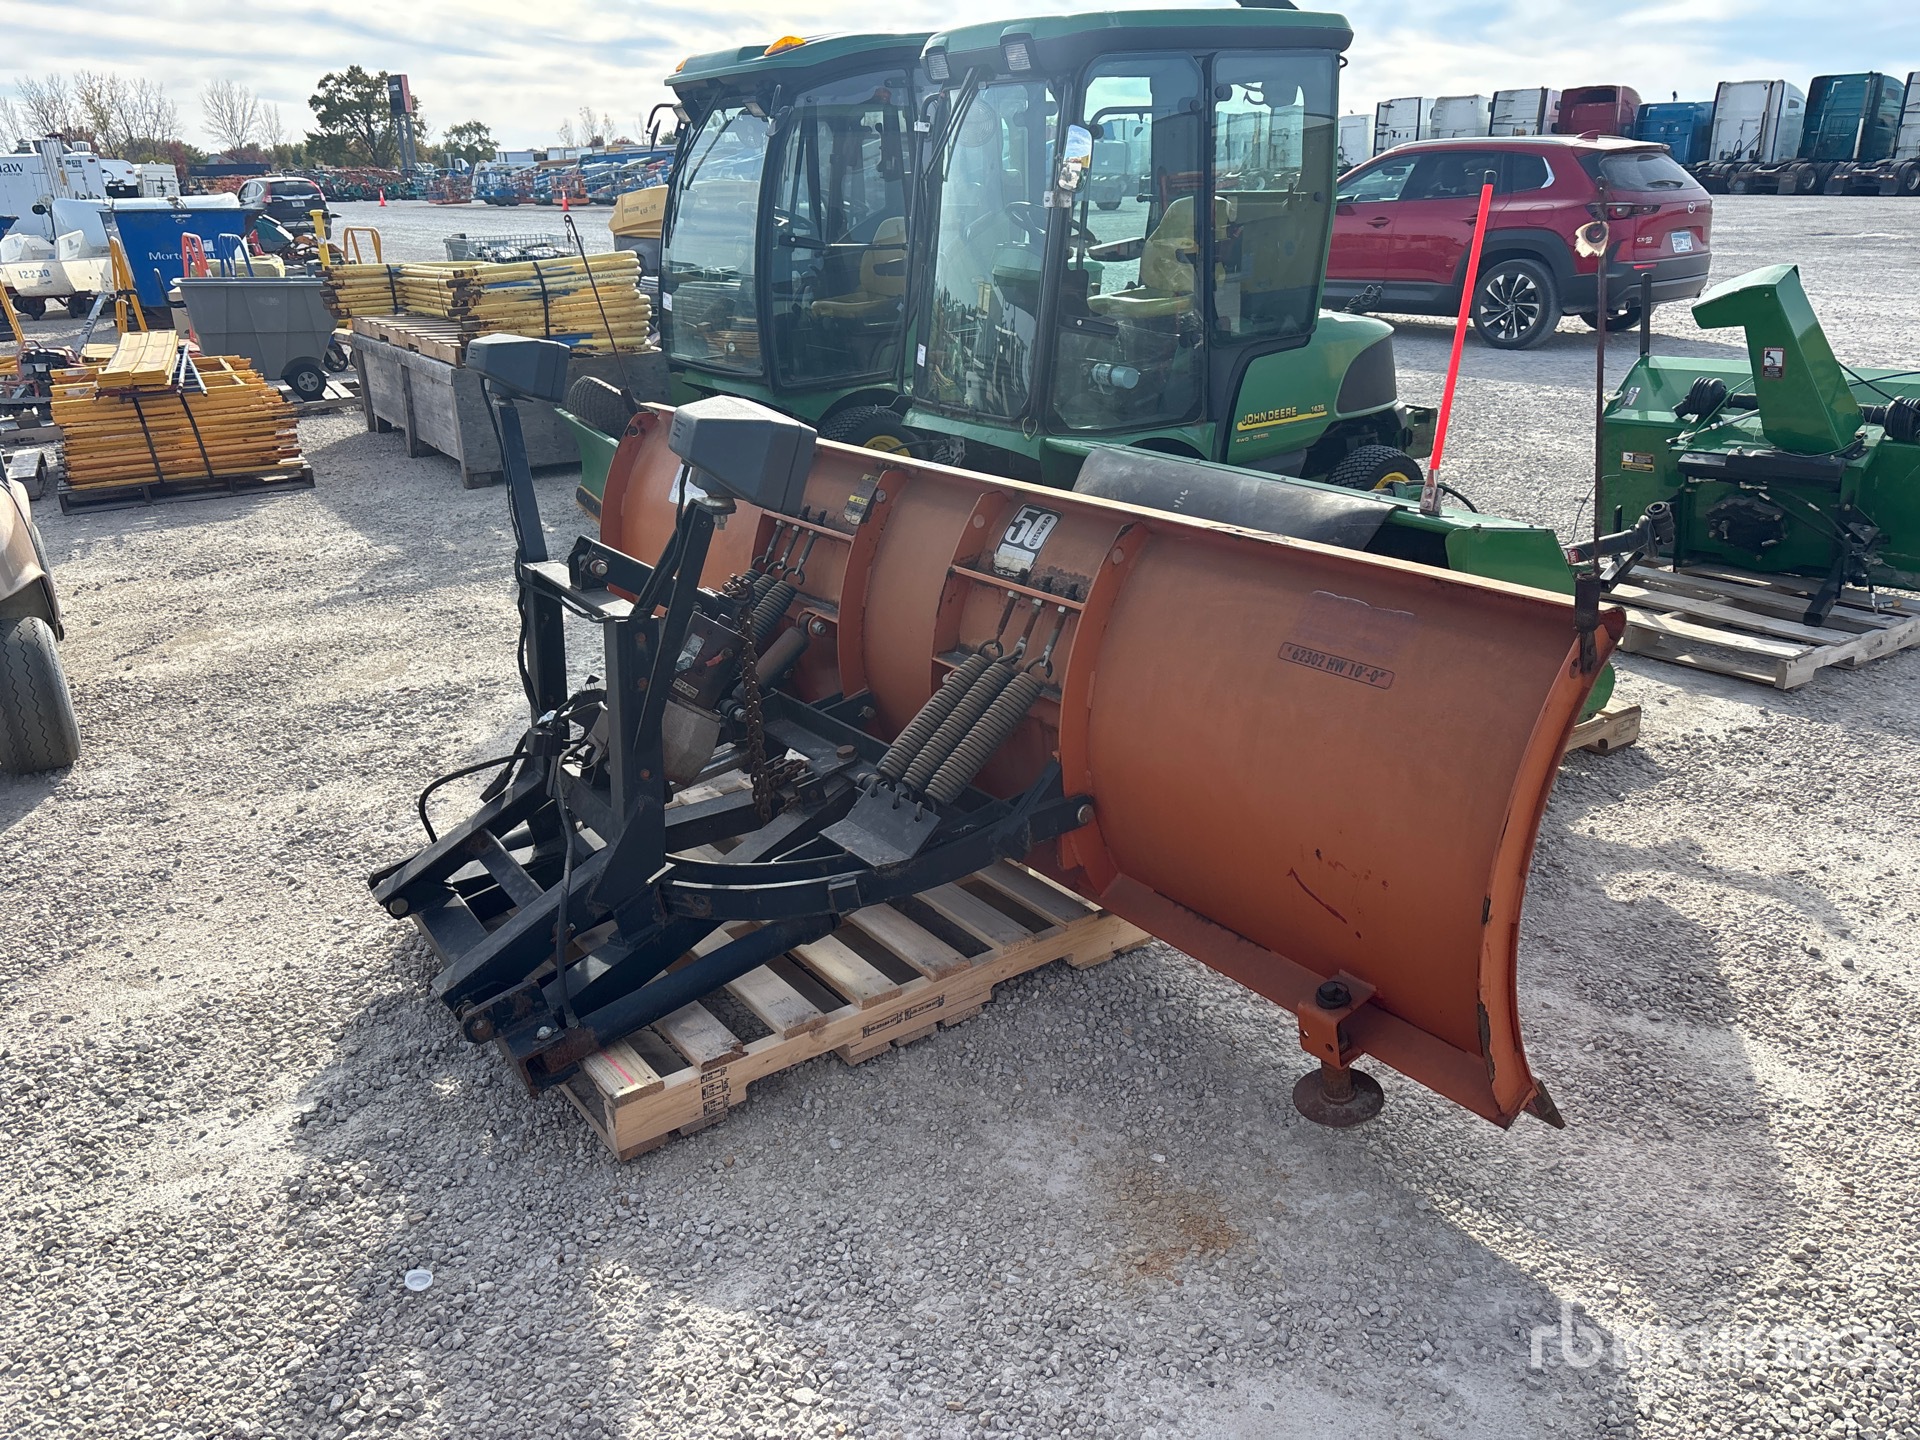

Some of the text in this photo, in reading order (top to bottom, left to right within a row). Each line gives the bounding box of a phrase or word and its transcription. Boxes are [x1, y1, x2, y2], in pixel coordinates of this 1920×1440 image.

[1242, 411, 1267, 425] JOHN
[1268, 406, 1298, 420] DEERE
[1004, 507, 1058, 550] 50
[1326, 657, 1347, 673] HW
